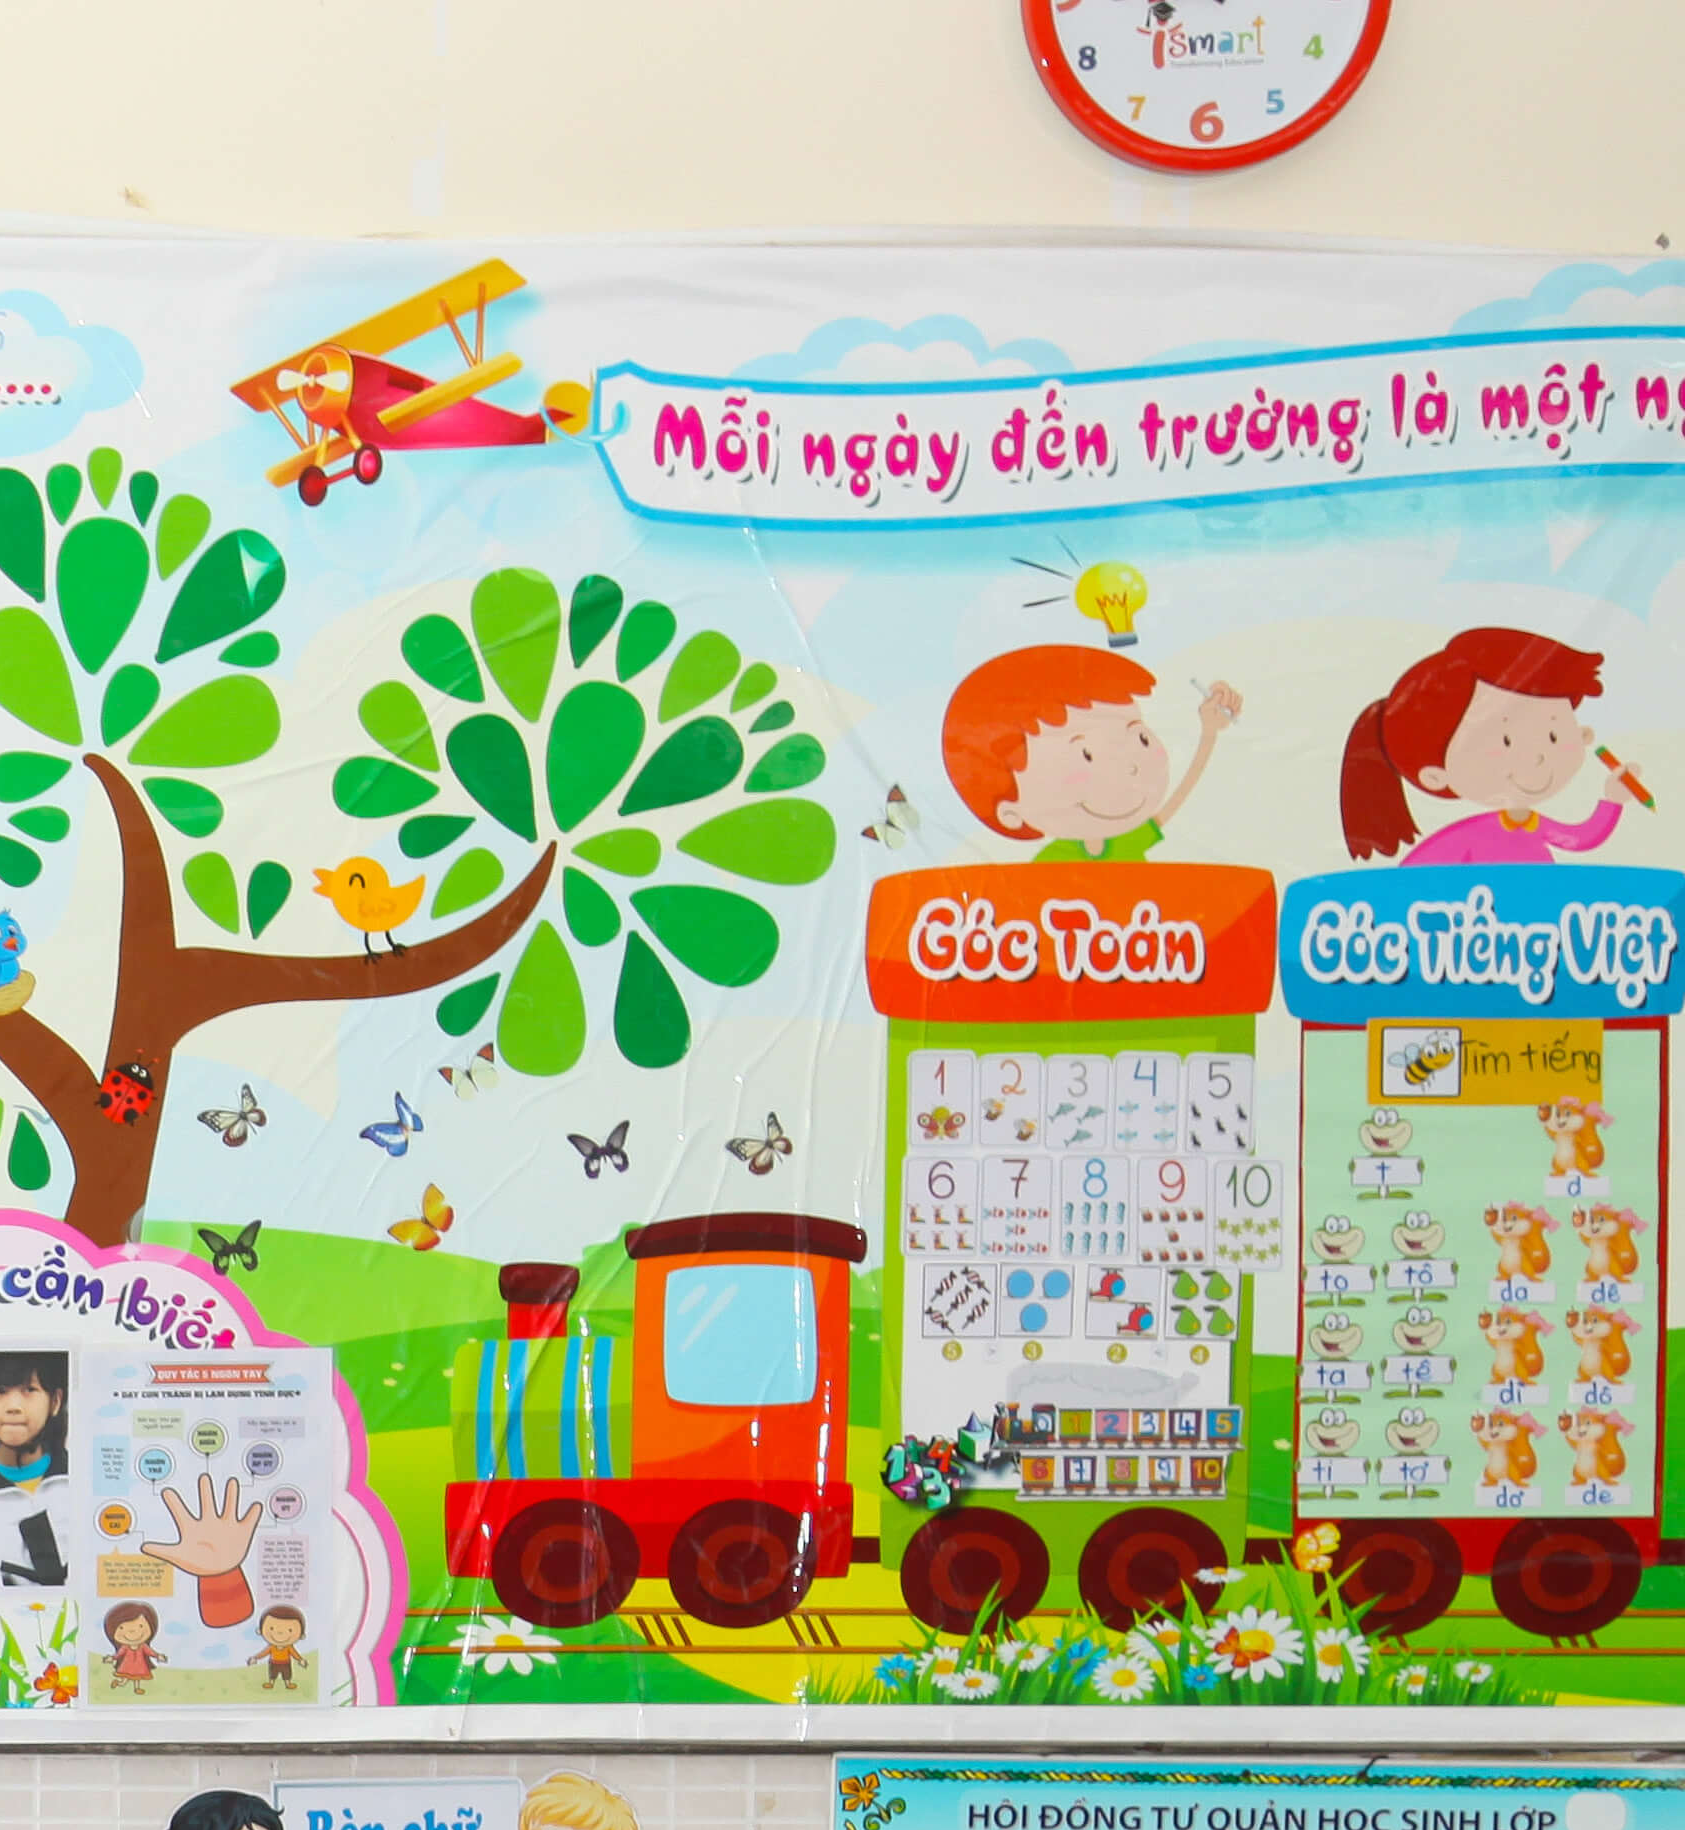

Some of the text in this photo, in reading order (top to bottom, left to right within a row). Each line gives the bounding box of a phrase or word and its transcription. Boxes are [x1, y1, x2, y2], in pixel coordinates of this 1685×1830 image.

[1078, 45, 1097, 70] 8
[1303, 34, 1324, 60] 4
[1127, 95, 1147, 120] 7
[1266, 89, 1285, 114] 5
[1189, 101, 1224, 142] 6
[653, 395, 771, 477] Mỗi
[802, 411, 960, 499] ngày
[991, 387, 1109, 473] đến
[1139, 386, 1361, 465] trường
[1391, 371, 1449, 437] là
[1481, 362, 1606, 450] một
[911, 899, 1204, 981] Góc Toán
[1301, 886, 1677, 1007] Góc Tiếng Việt
[1458, 1031, 1602, 1084] Tìm tiếng
[933, 1060, 945, 1096] 1
[1000, 1059, 1026, 1095] 2
[1067, 1062, 1088, 1098] 3
[1134, 1059, 1157, 1097] 4
[1208, 1062, 1231, 1099] 5
[929, 1161, 955, 1199] 6
[1002, 1159, 1029, 1198] 7
[1082, 1158, 1108, 1198] 8
[1158, 1161, 1185, 1203] 9
[1227, 1165, 1272, 1207] 10
[1567, 1176, 1582, 1197] d
[2, 1244, 105, 1312] cần
[1320, 1270, 1349, 1292] to
[1404, 1262, 1434, 1285] tô
[1500, 1280, 1528, 1302] da
[1317, 1364, 1346, 1386] ta
[1312, 1460, 1333, 1481] ti
